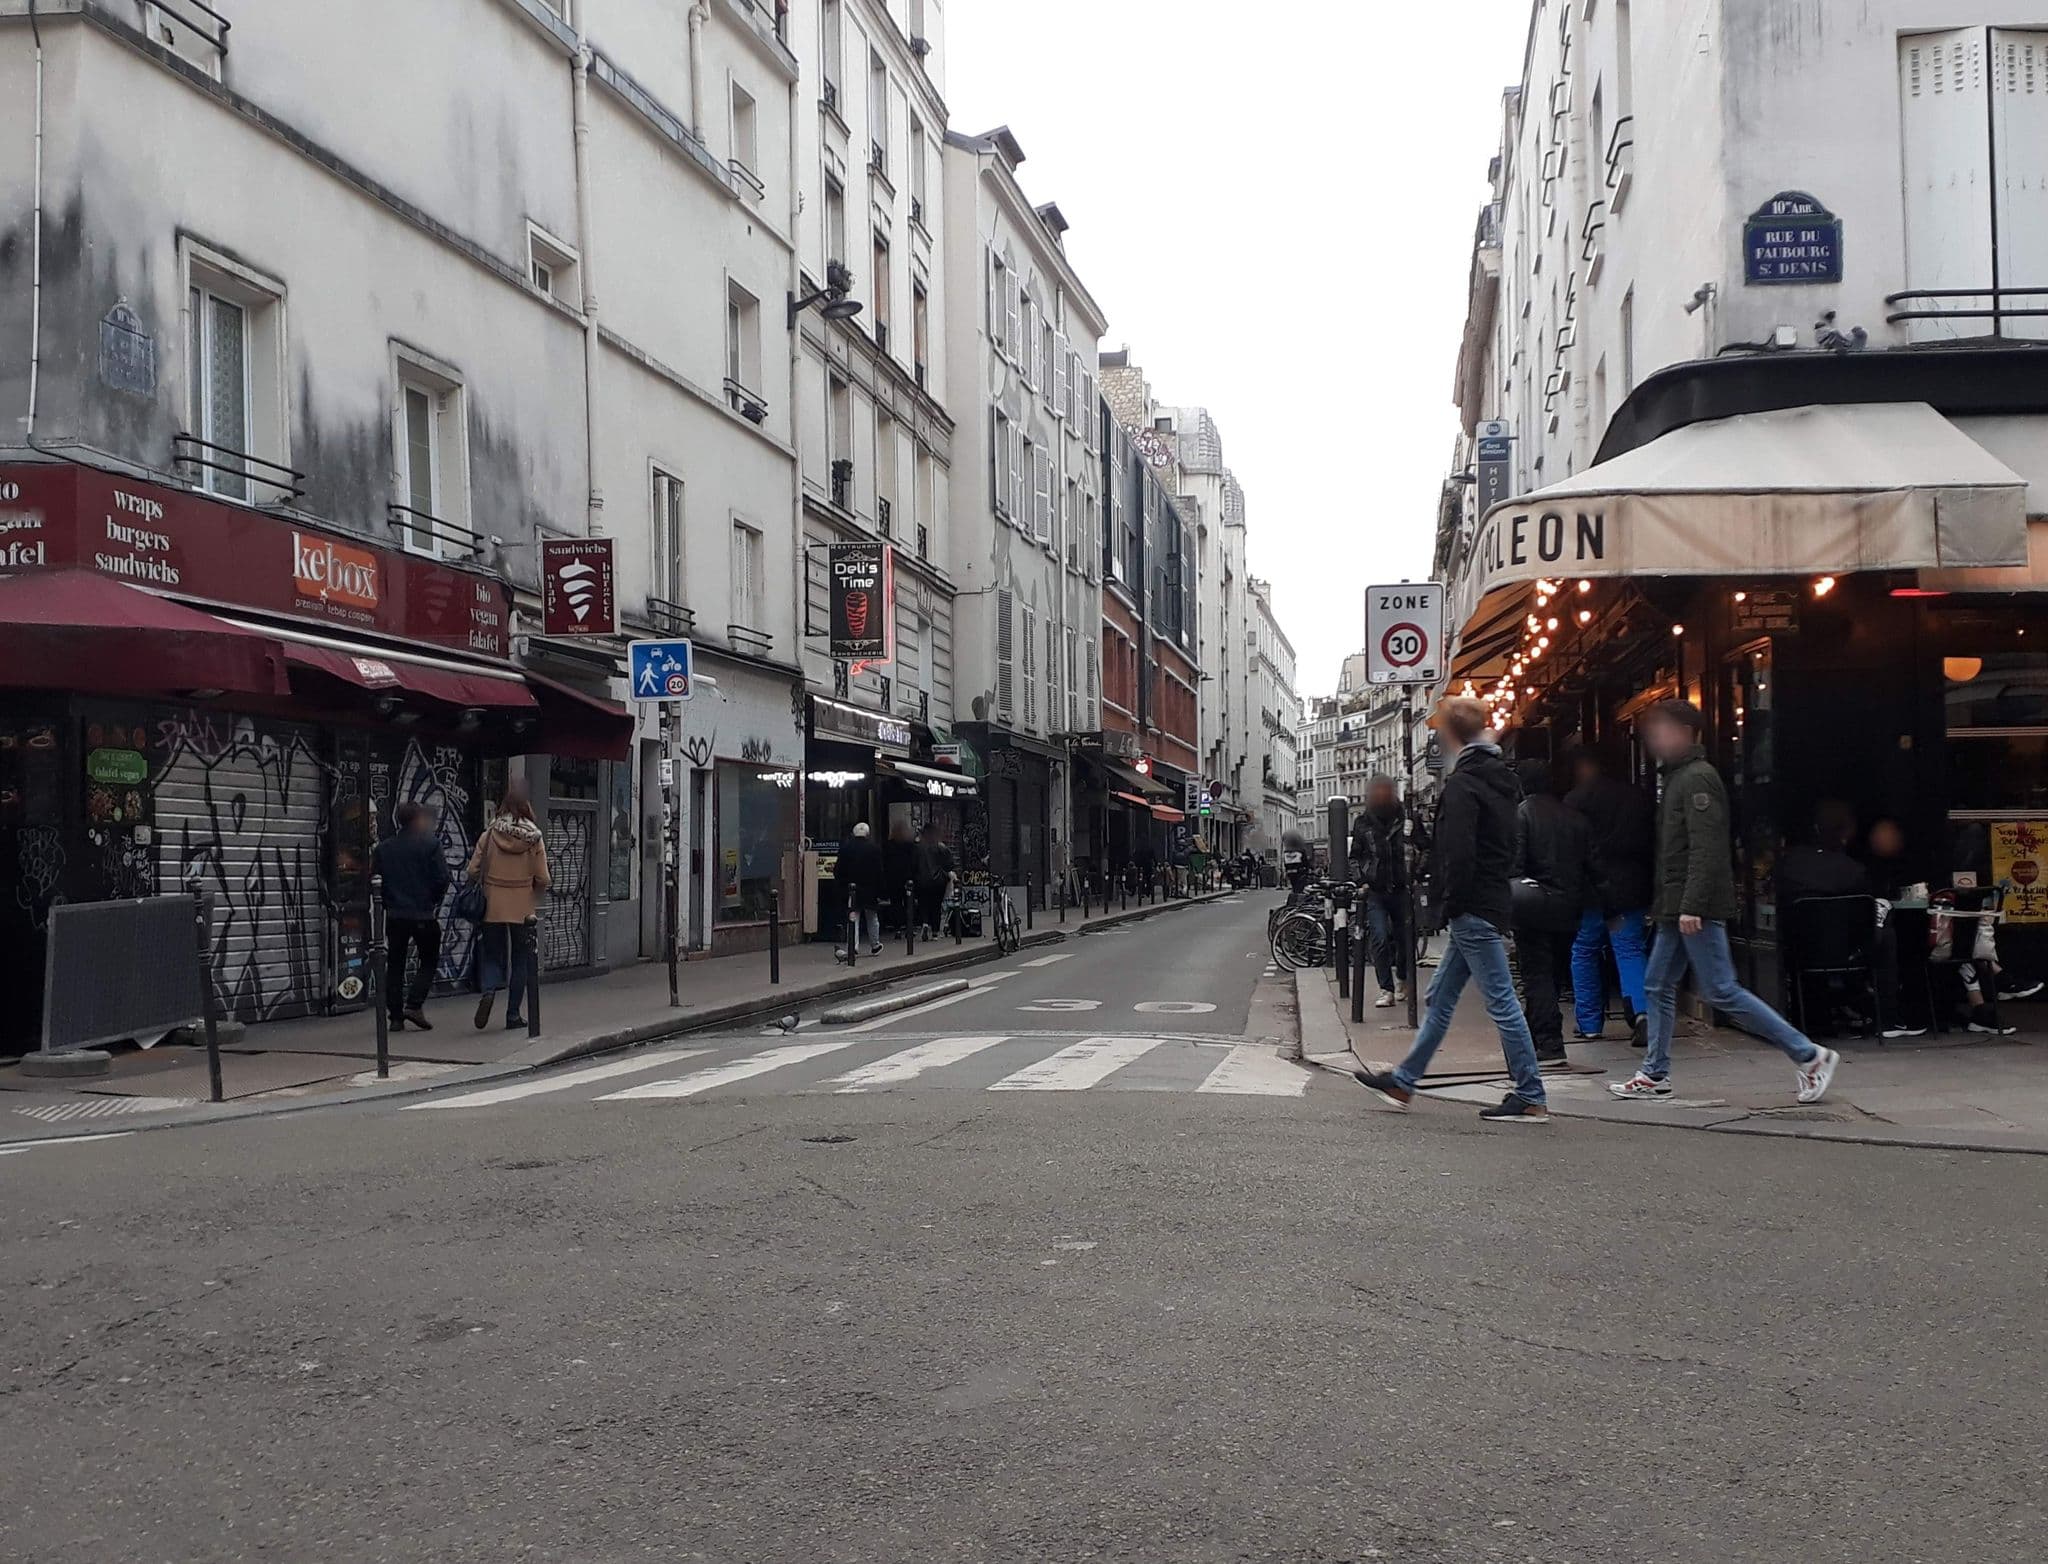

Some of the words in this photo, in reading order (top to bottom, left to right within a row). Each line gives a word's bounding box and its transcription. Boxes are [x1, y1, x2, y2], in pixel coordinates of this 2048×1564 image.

[1766, 230, 1795, 243] RUE
[1801, 230, 1820, 242] DU
[1756, 245, 1830, 259] FAUBOURG
[1780, 261, 1827, 274] DENIS
[1489, 467, 1498, 505] HOTE
[113, 490, 163, 522] wraps
[106, 514, 169, 552] burgers
[549, 543, 607, 555] sandwichs
[95, 552, 180, 585] sandwichs
[291, 531, 377, 600] kebox
[834, 562, 878, 574] Deli's
[839, 576, 874, 588] Time
[475, 583, 491, 603] bio
[1380, 595, 1429, 610] ZONE
[470, 607, 498, 626] vegan
[469, 629, 499, 652] falafel
[1391, 636, 1418, 655] 30
[671, 680, 683, 689] 20
